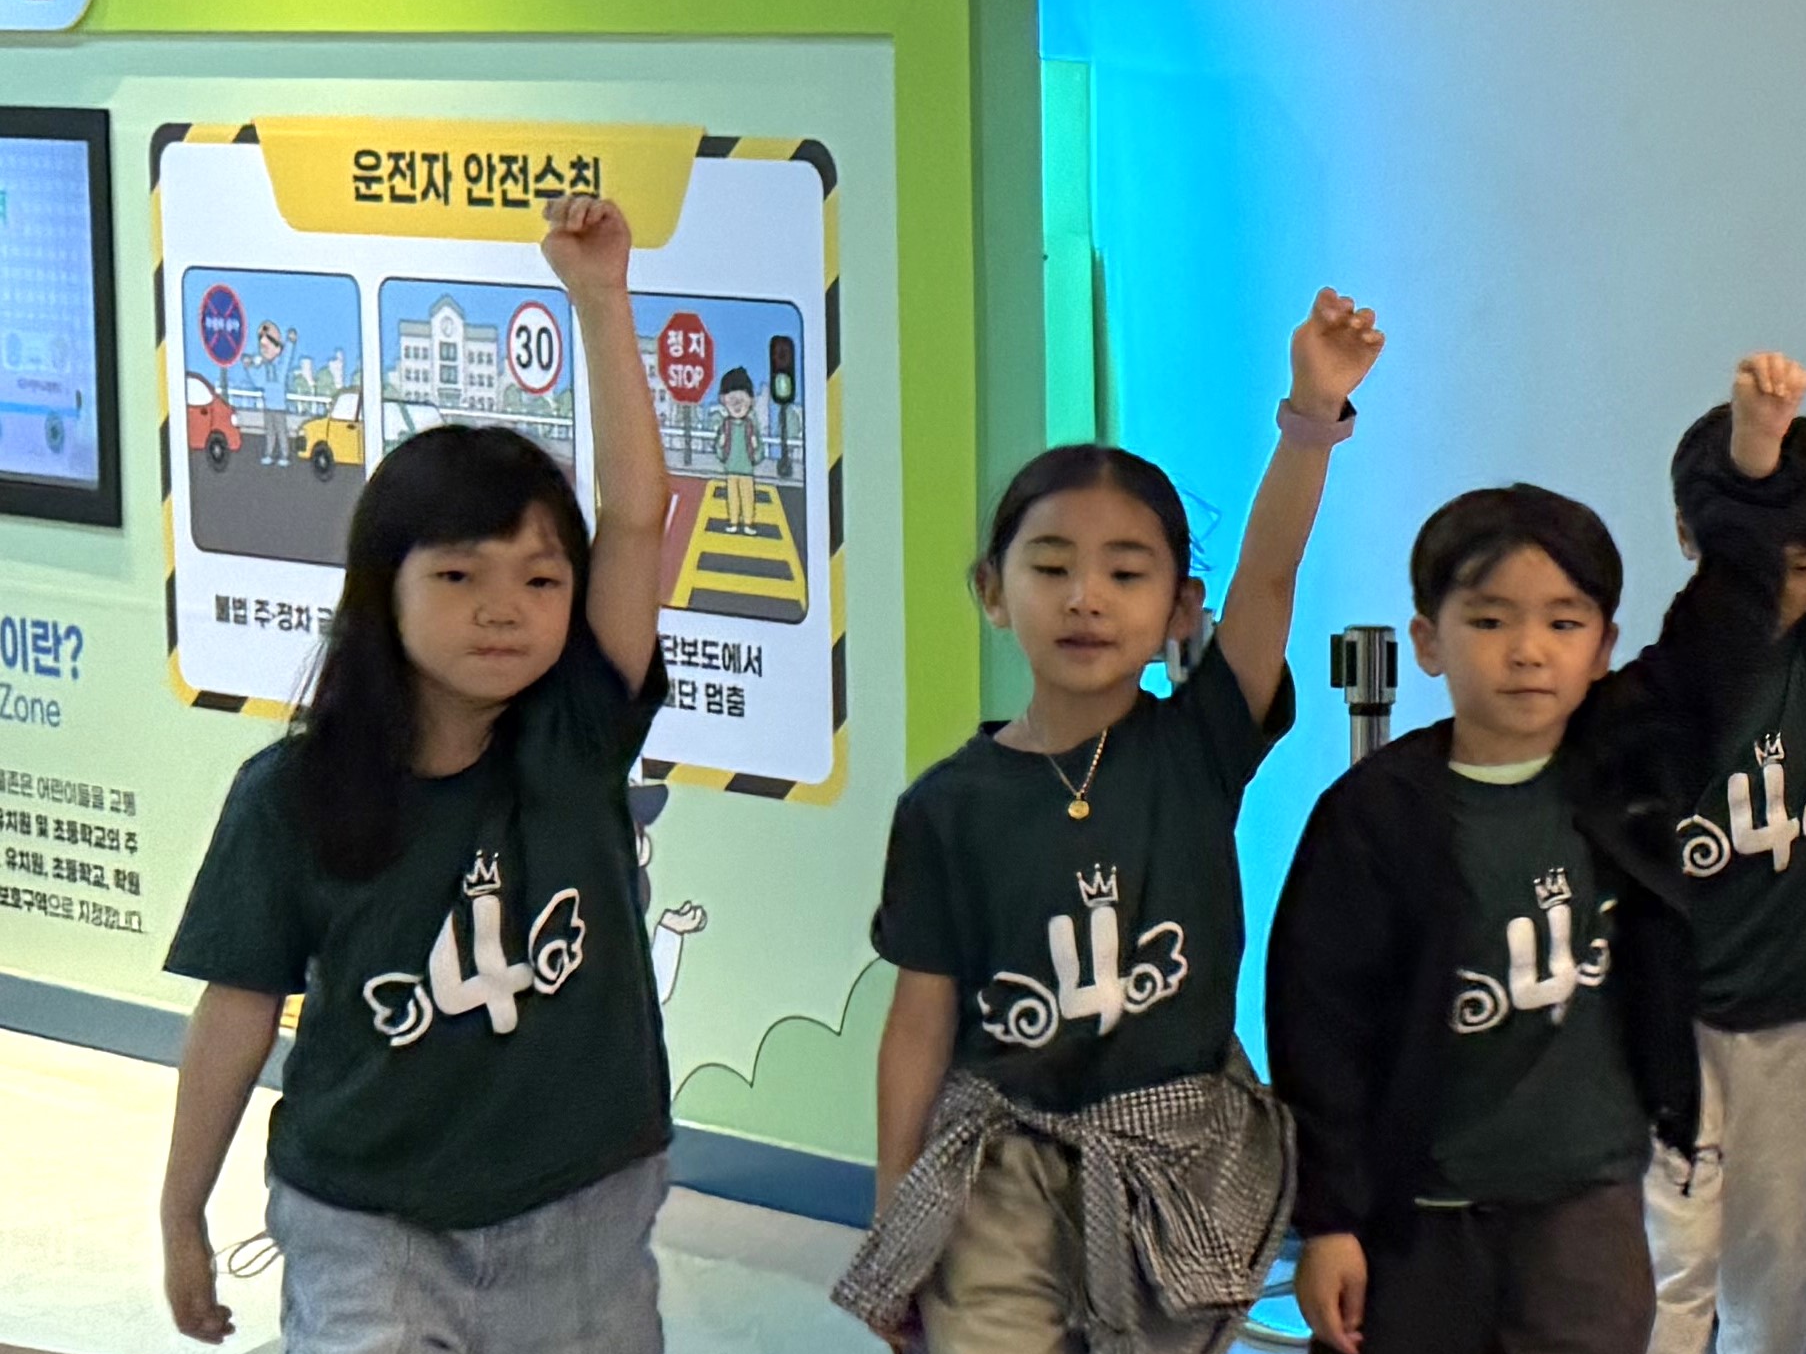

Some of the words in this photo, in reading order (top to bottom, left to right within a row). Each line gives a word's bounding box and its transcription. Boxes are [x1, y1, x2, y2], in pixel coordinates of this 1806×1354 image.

[353, 148, 451, 206] 운전자
[514, 324, 554, 371] 30
[667, 363, 704, 390] STOP
[0, 616, 83, 680] 이란?
[0, 681, 61, 727] Zone
[705, 682, 746, 719] 멈춤
[37, 775, 105, 812] 어린이들을
[1727, 762, 1800, 872] 4
[53, 818, 121, 853] 초등학교의
[125, 831, 139, 855] 주
[429, 894, 535, 1034] 4
[1048, 906, 1125, 1037] 4
